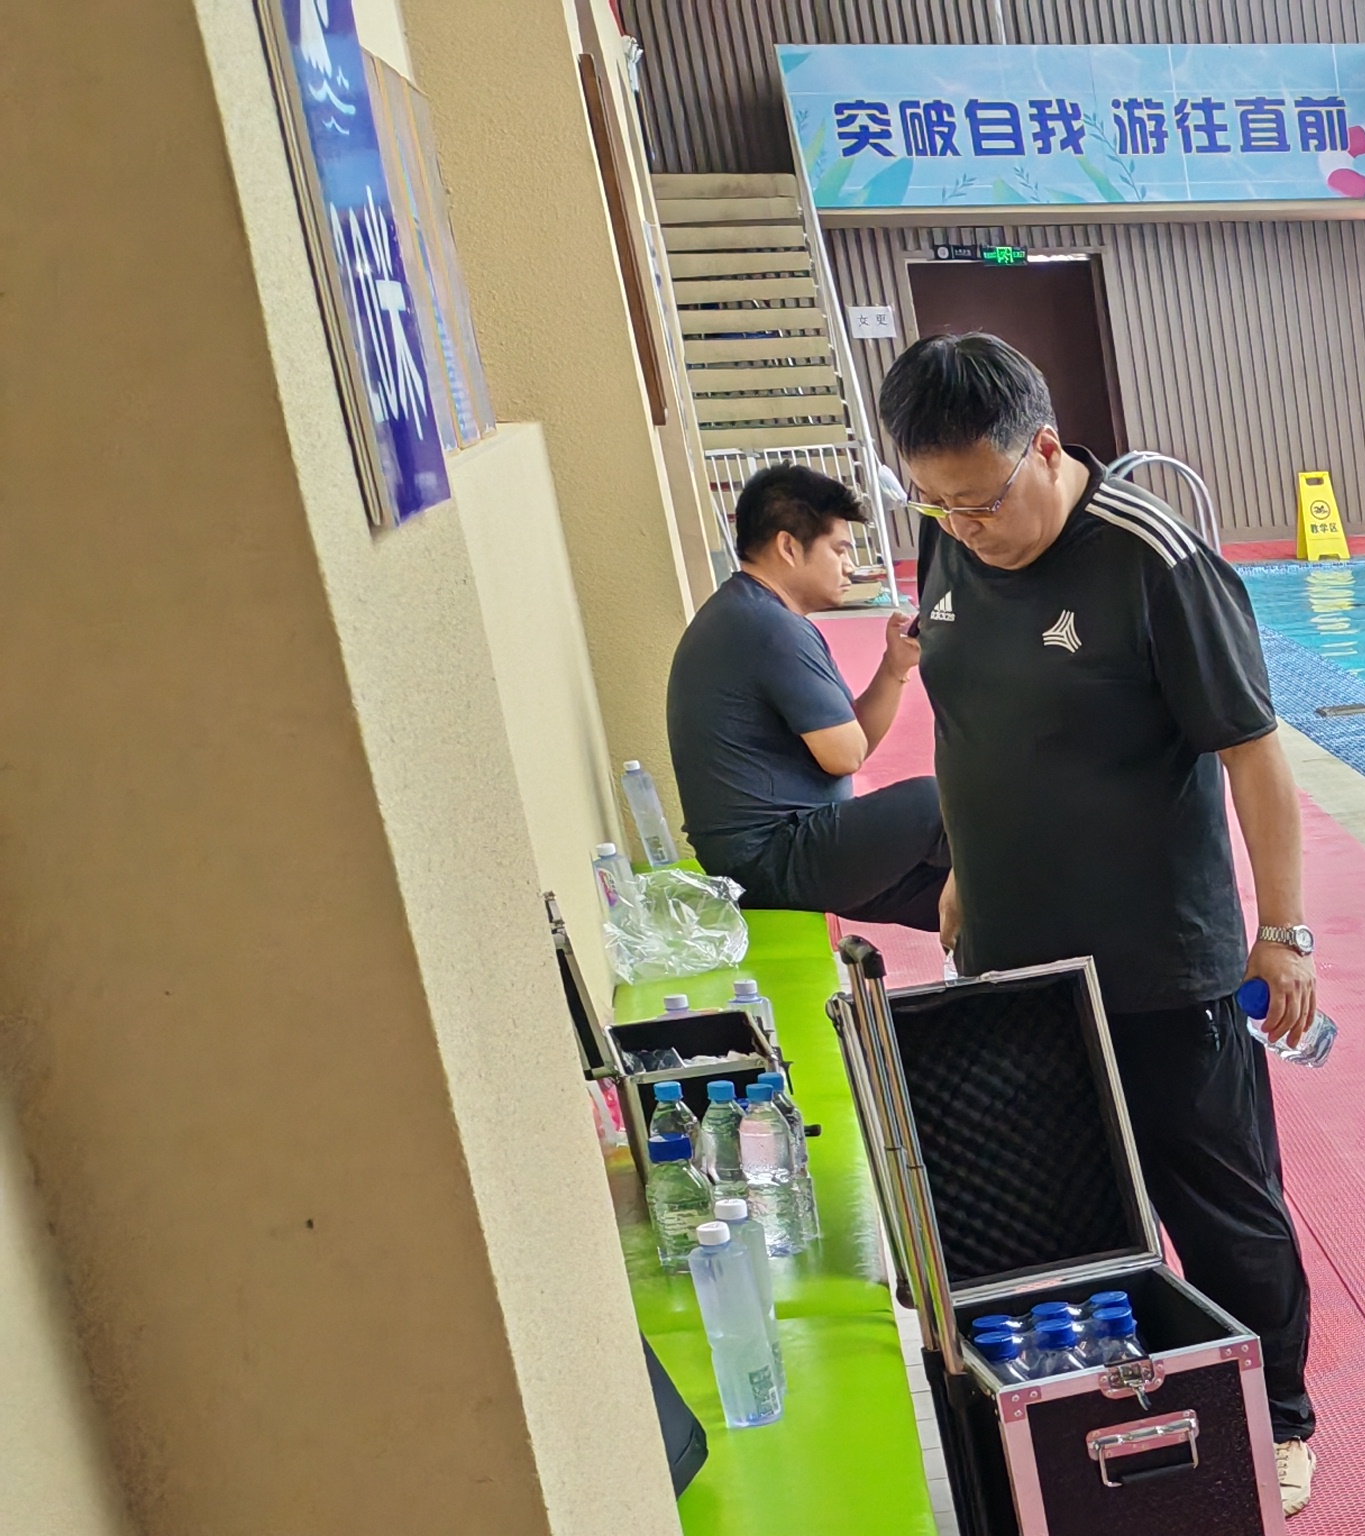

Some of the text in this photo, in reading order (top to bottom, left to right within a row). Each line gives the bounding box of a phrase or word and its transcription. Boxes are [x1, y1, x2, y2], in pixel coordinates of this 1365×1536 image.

[833, 98, 1085, 158] 突破自我
[1111, 97, 1349, 154] 游往直前
[1309, 522, 1339, 535] 教学区
